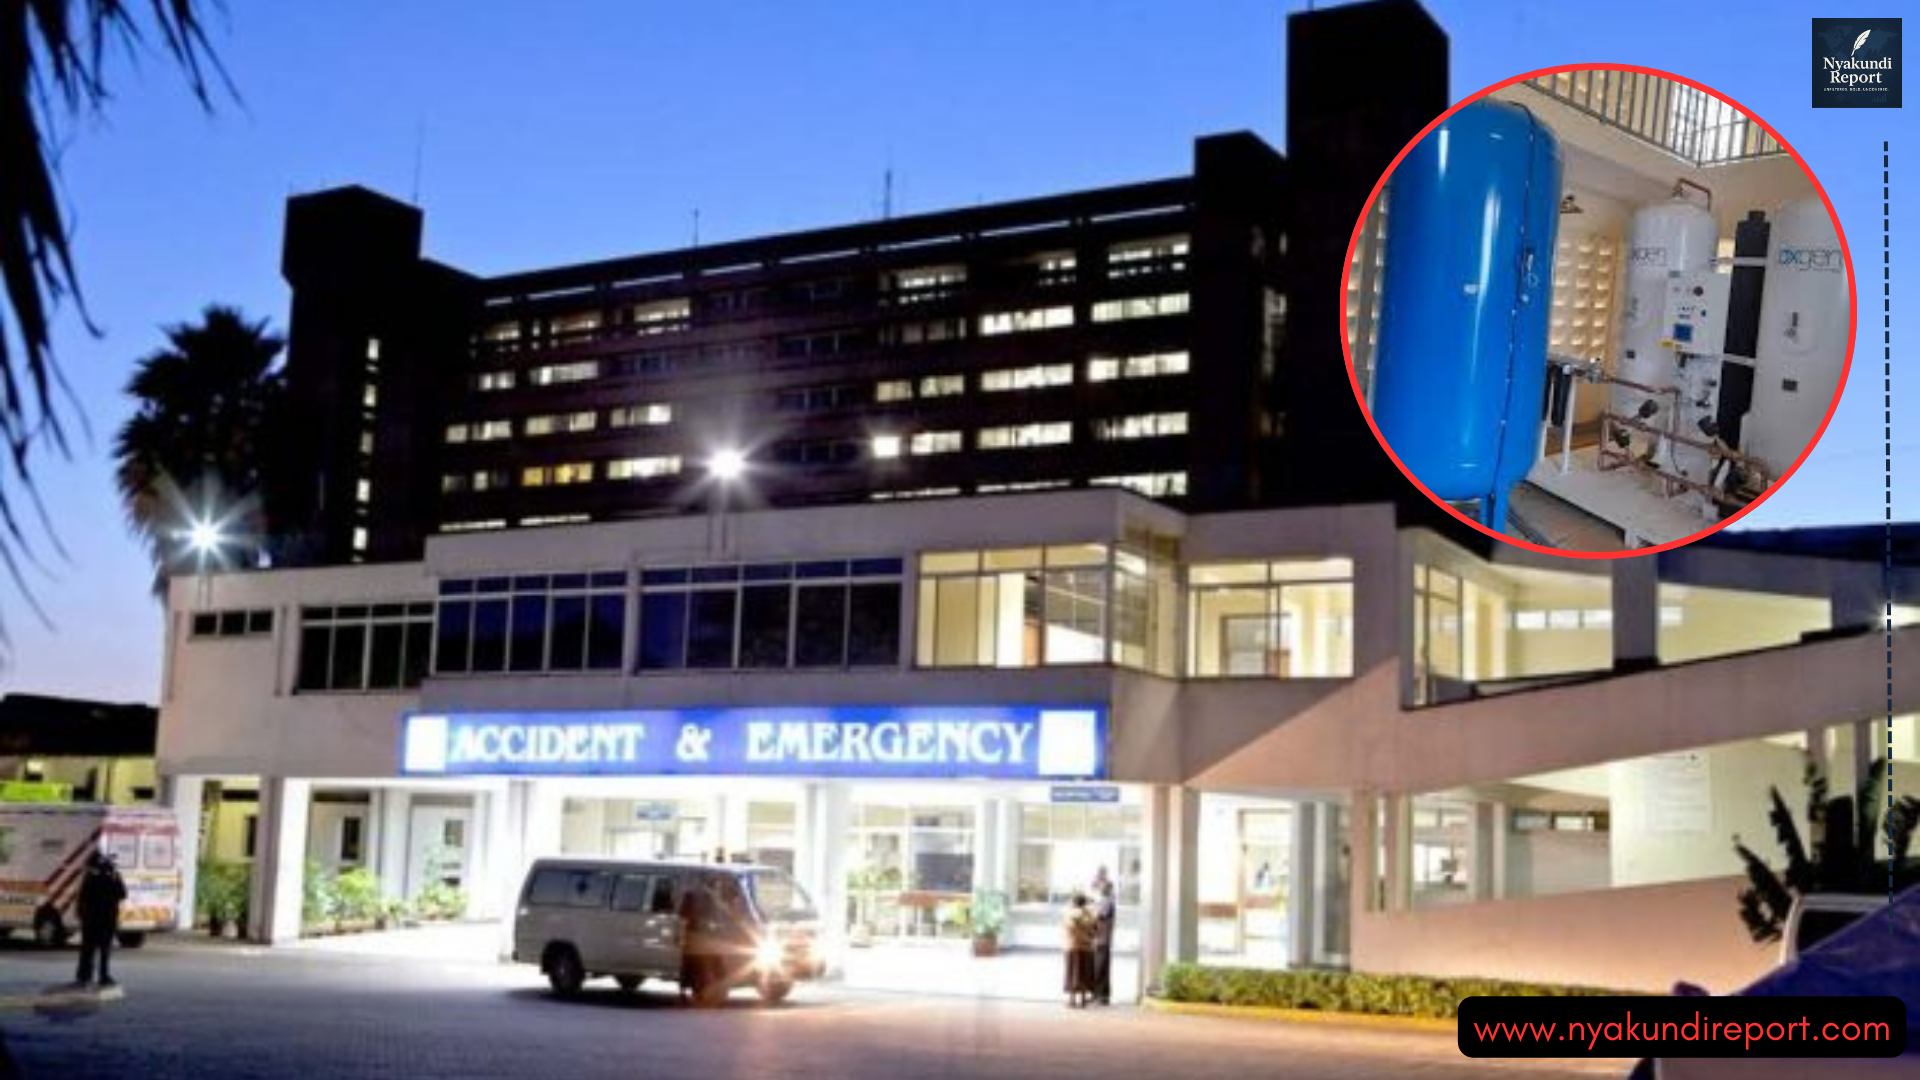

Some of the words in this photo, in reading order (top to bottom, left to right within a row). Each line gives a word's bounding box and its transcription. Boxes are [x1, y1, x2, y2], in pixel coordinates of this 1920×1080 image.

[450, 722, 644, 763] ACCIDENT
[675, 722, 712, 762] &
[746, 720, 1033, 764] EMERGENCY
